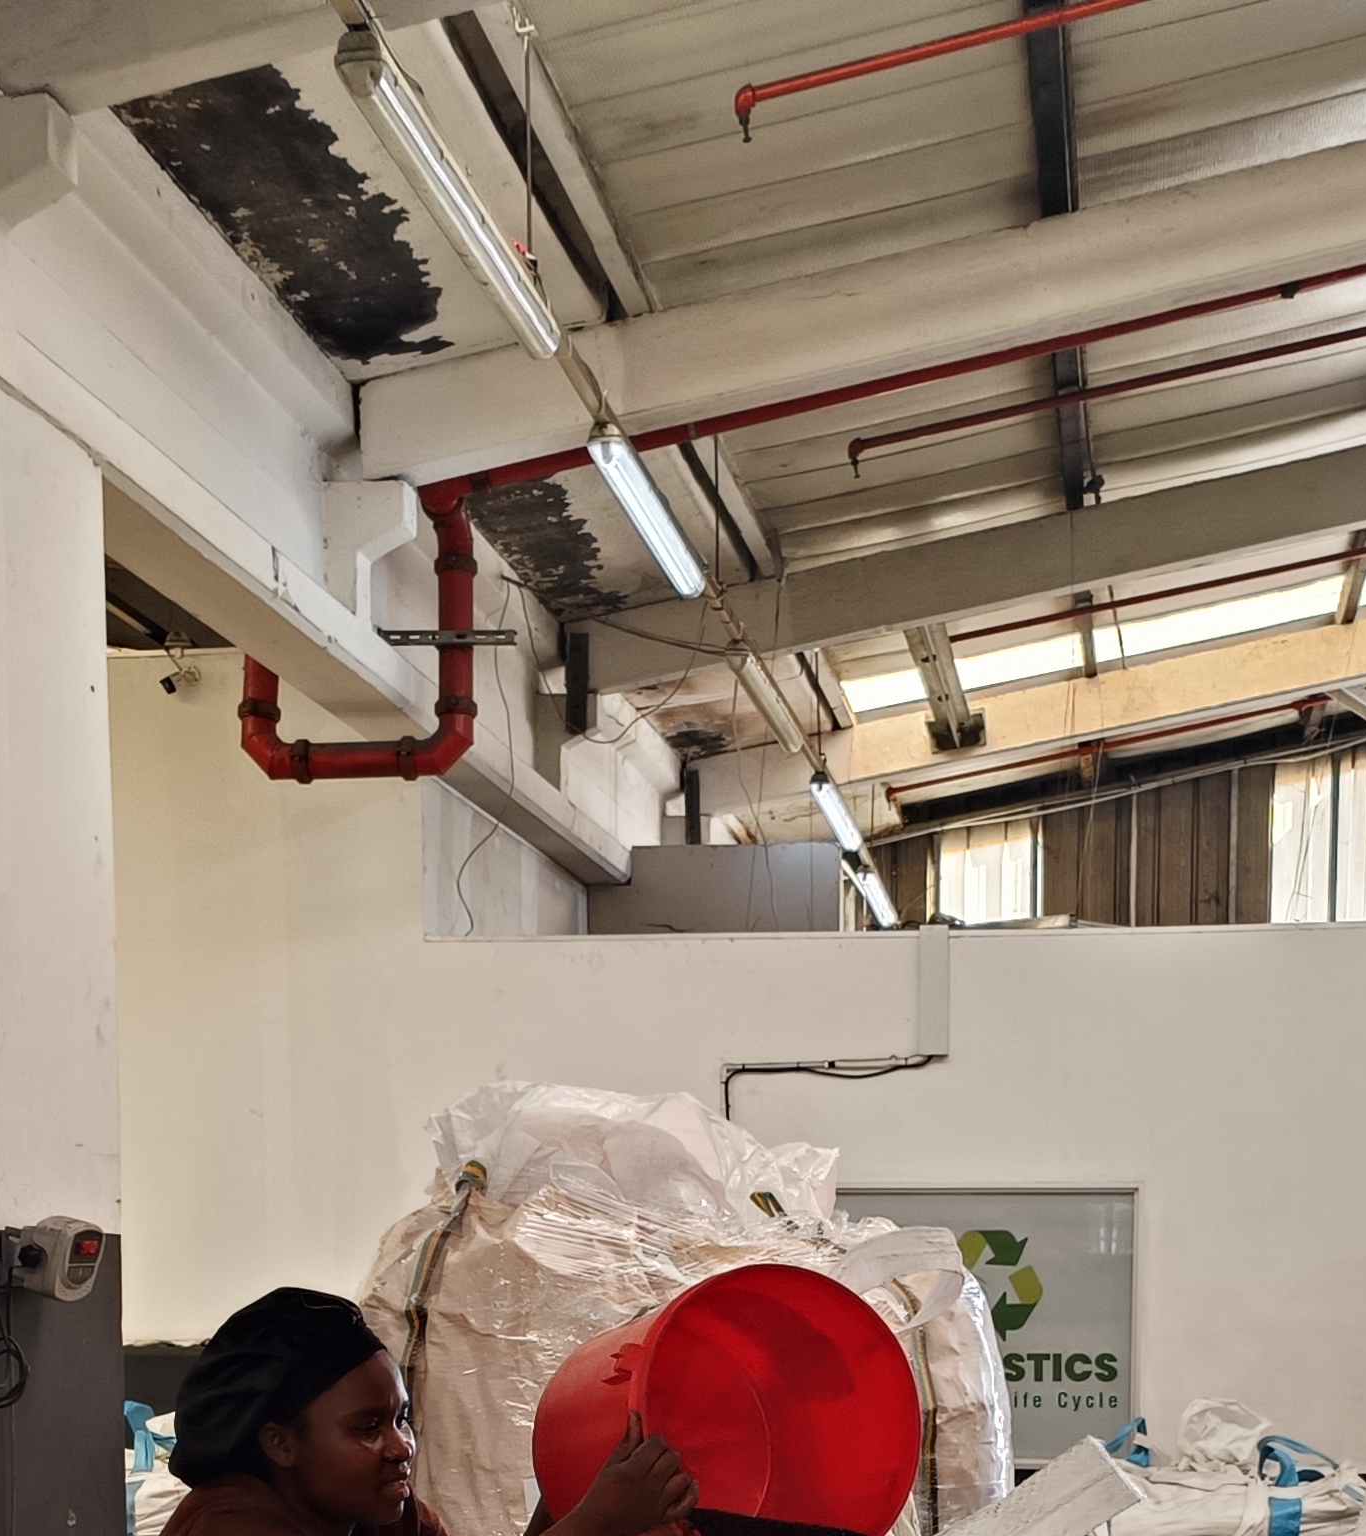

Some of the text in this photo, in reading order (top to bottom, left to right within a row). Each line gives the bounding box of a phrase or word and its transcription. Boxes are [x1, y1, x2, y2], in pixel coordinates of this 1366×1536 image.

[1002, 1352, 1119, 1383] STICS
[1013, 1391, 1118, 1412] ife Cycle
